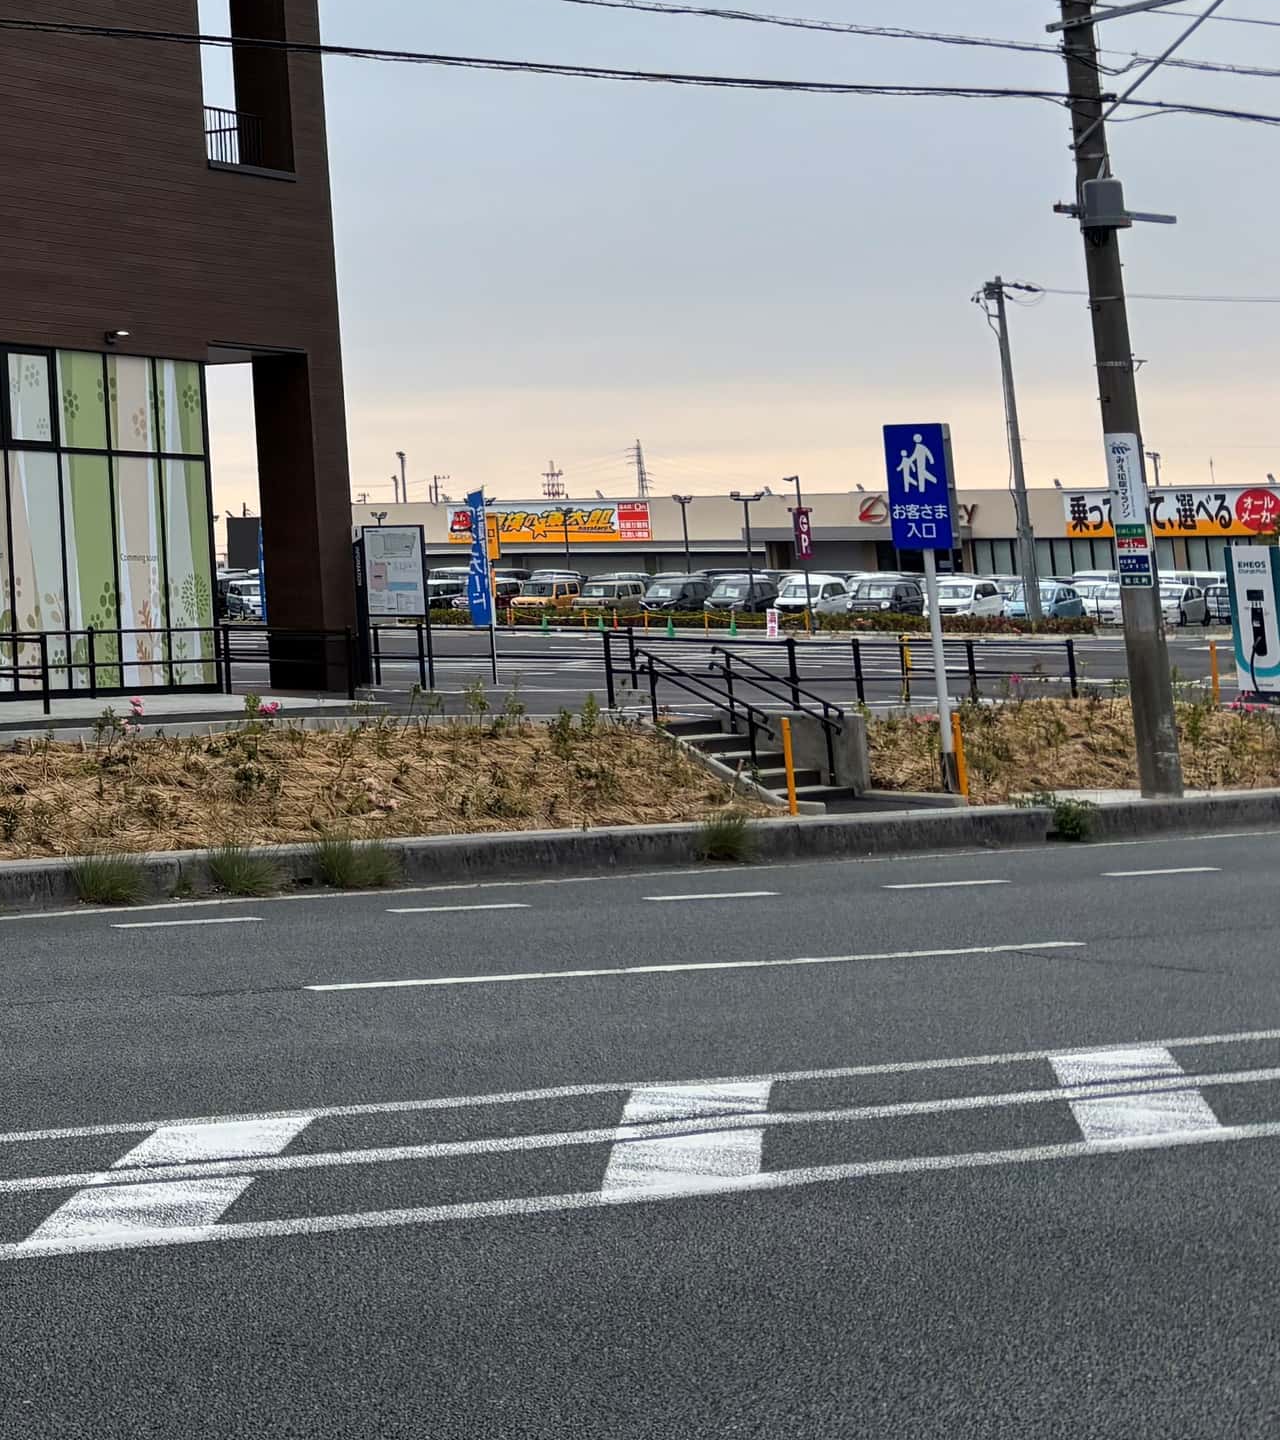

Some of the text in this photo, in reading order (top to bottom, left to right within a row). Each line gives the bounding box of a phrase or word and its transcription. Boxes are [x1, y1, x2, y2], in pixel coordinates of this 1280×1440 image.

[1243, 495, 1274, 510] オール
[892, 503, 948, 520] お客さま
[907, 522, 936, 538] 入口
